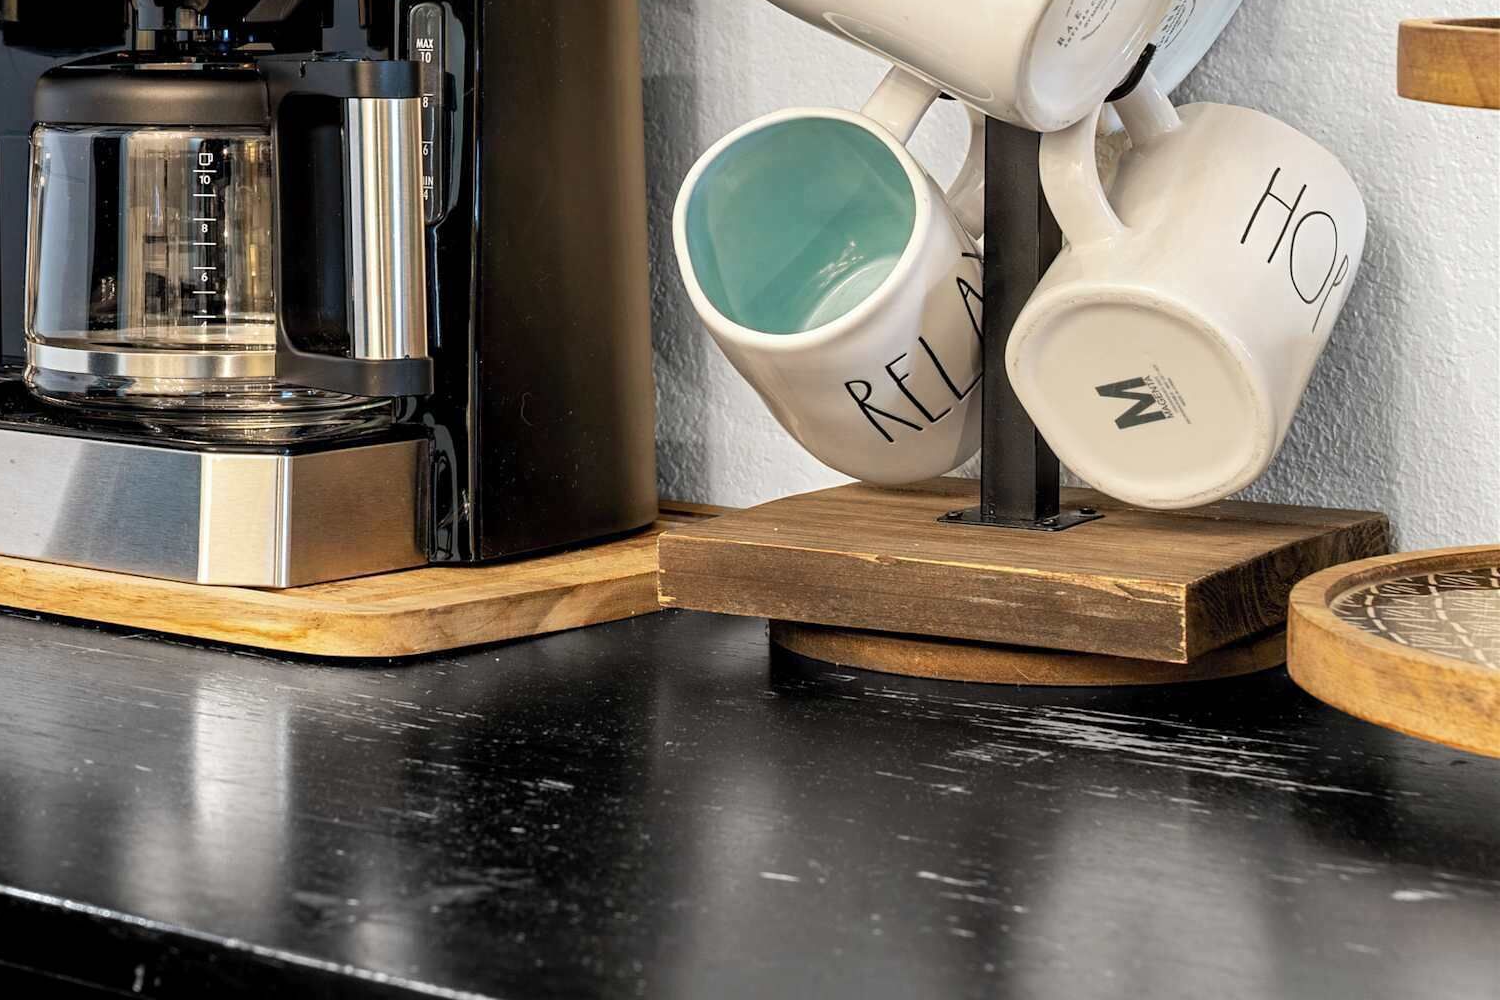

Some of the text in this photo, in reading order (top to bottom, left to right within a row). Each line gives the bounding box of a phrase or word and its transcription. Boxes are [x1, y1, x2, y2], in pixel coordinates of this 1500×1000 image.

[416, 38, 434, 49] MAX
[420, 51, 432, 63] 10
[422, 96, 429, 108] 8
[422, 144, 429, 155] 6
[199, 175, 211, 185] 10
[201, 223, 208, 233] 8
[201, 272, 208, 282] 6
[844, 251, 984, 443] RELA
